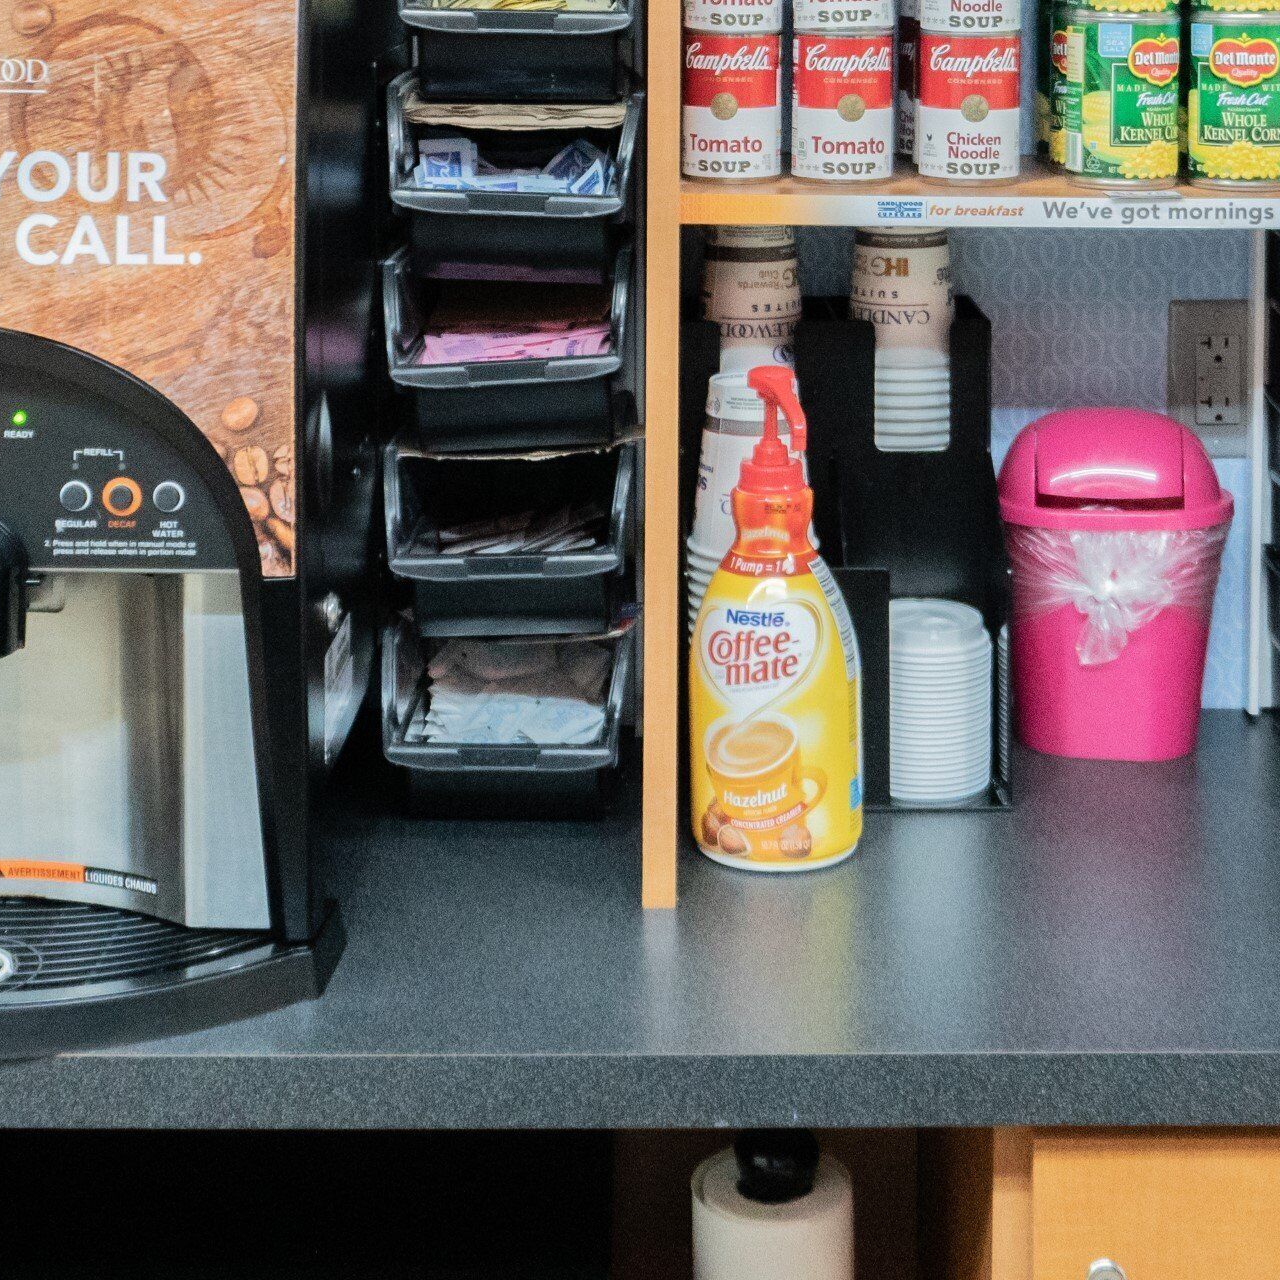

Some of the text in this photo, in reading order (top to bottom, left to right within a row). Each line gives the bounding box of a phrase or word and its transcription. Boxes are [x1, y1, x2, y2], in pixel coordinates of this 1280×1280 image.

[950, 0, 1003, 13] Noodle
[710, 12, 764, 26] SOUP
[818, 9, 872, 23] SOUP
[689, 133, 763, 153] Tomato
[946, 132, 1002, 147] Chicken
[948, 147, 1000, 160] Noodle
[929, 204, 952, 217] for
[954, 204, 1024, 217] breakfast
[1042, 201, 1114, 221] We've
[1120, 204, 1161, 225] got
[1168, 202, 1275, 225] mornings
[16, 213, 203, 266] CALL.
[3, 430, 34, 439] READY
[159, 521, 179, 529] HOT
[152, 530, 184, 538] WATER
[726, 608, 786, 627] Nestlé
[708, 630, 800, 666] Coffee-
[725, 652, 798, 686] mate
[723, 782, 788, 808] Hazelnut
[8, 867, 80, 880] AVERTISSEMENT
[85, 871, 123, 887] LIQUIDES
[125, 878, 157, 894] CHAUDS
